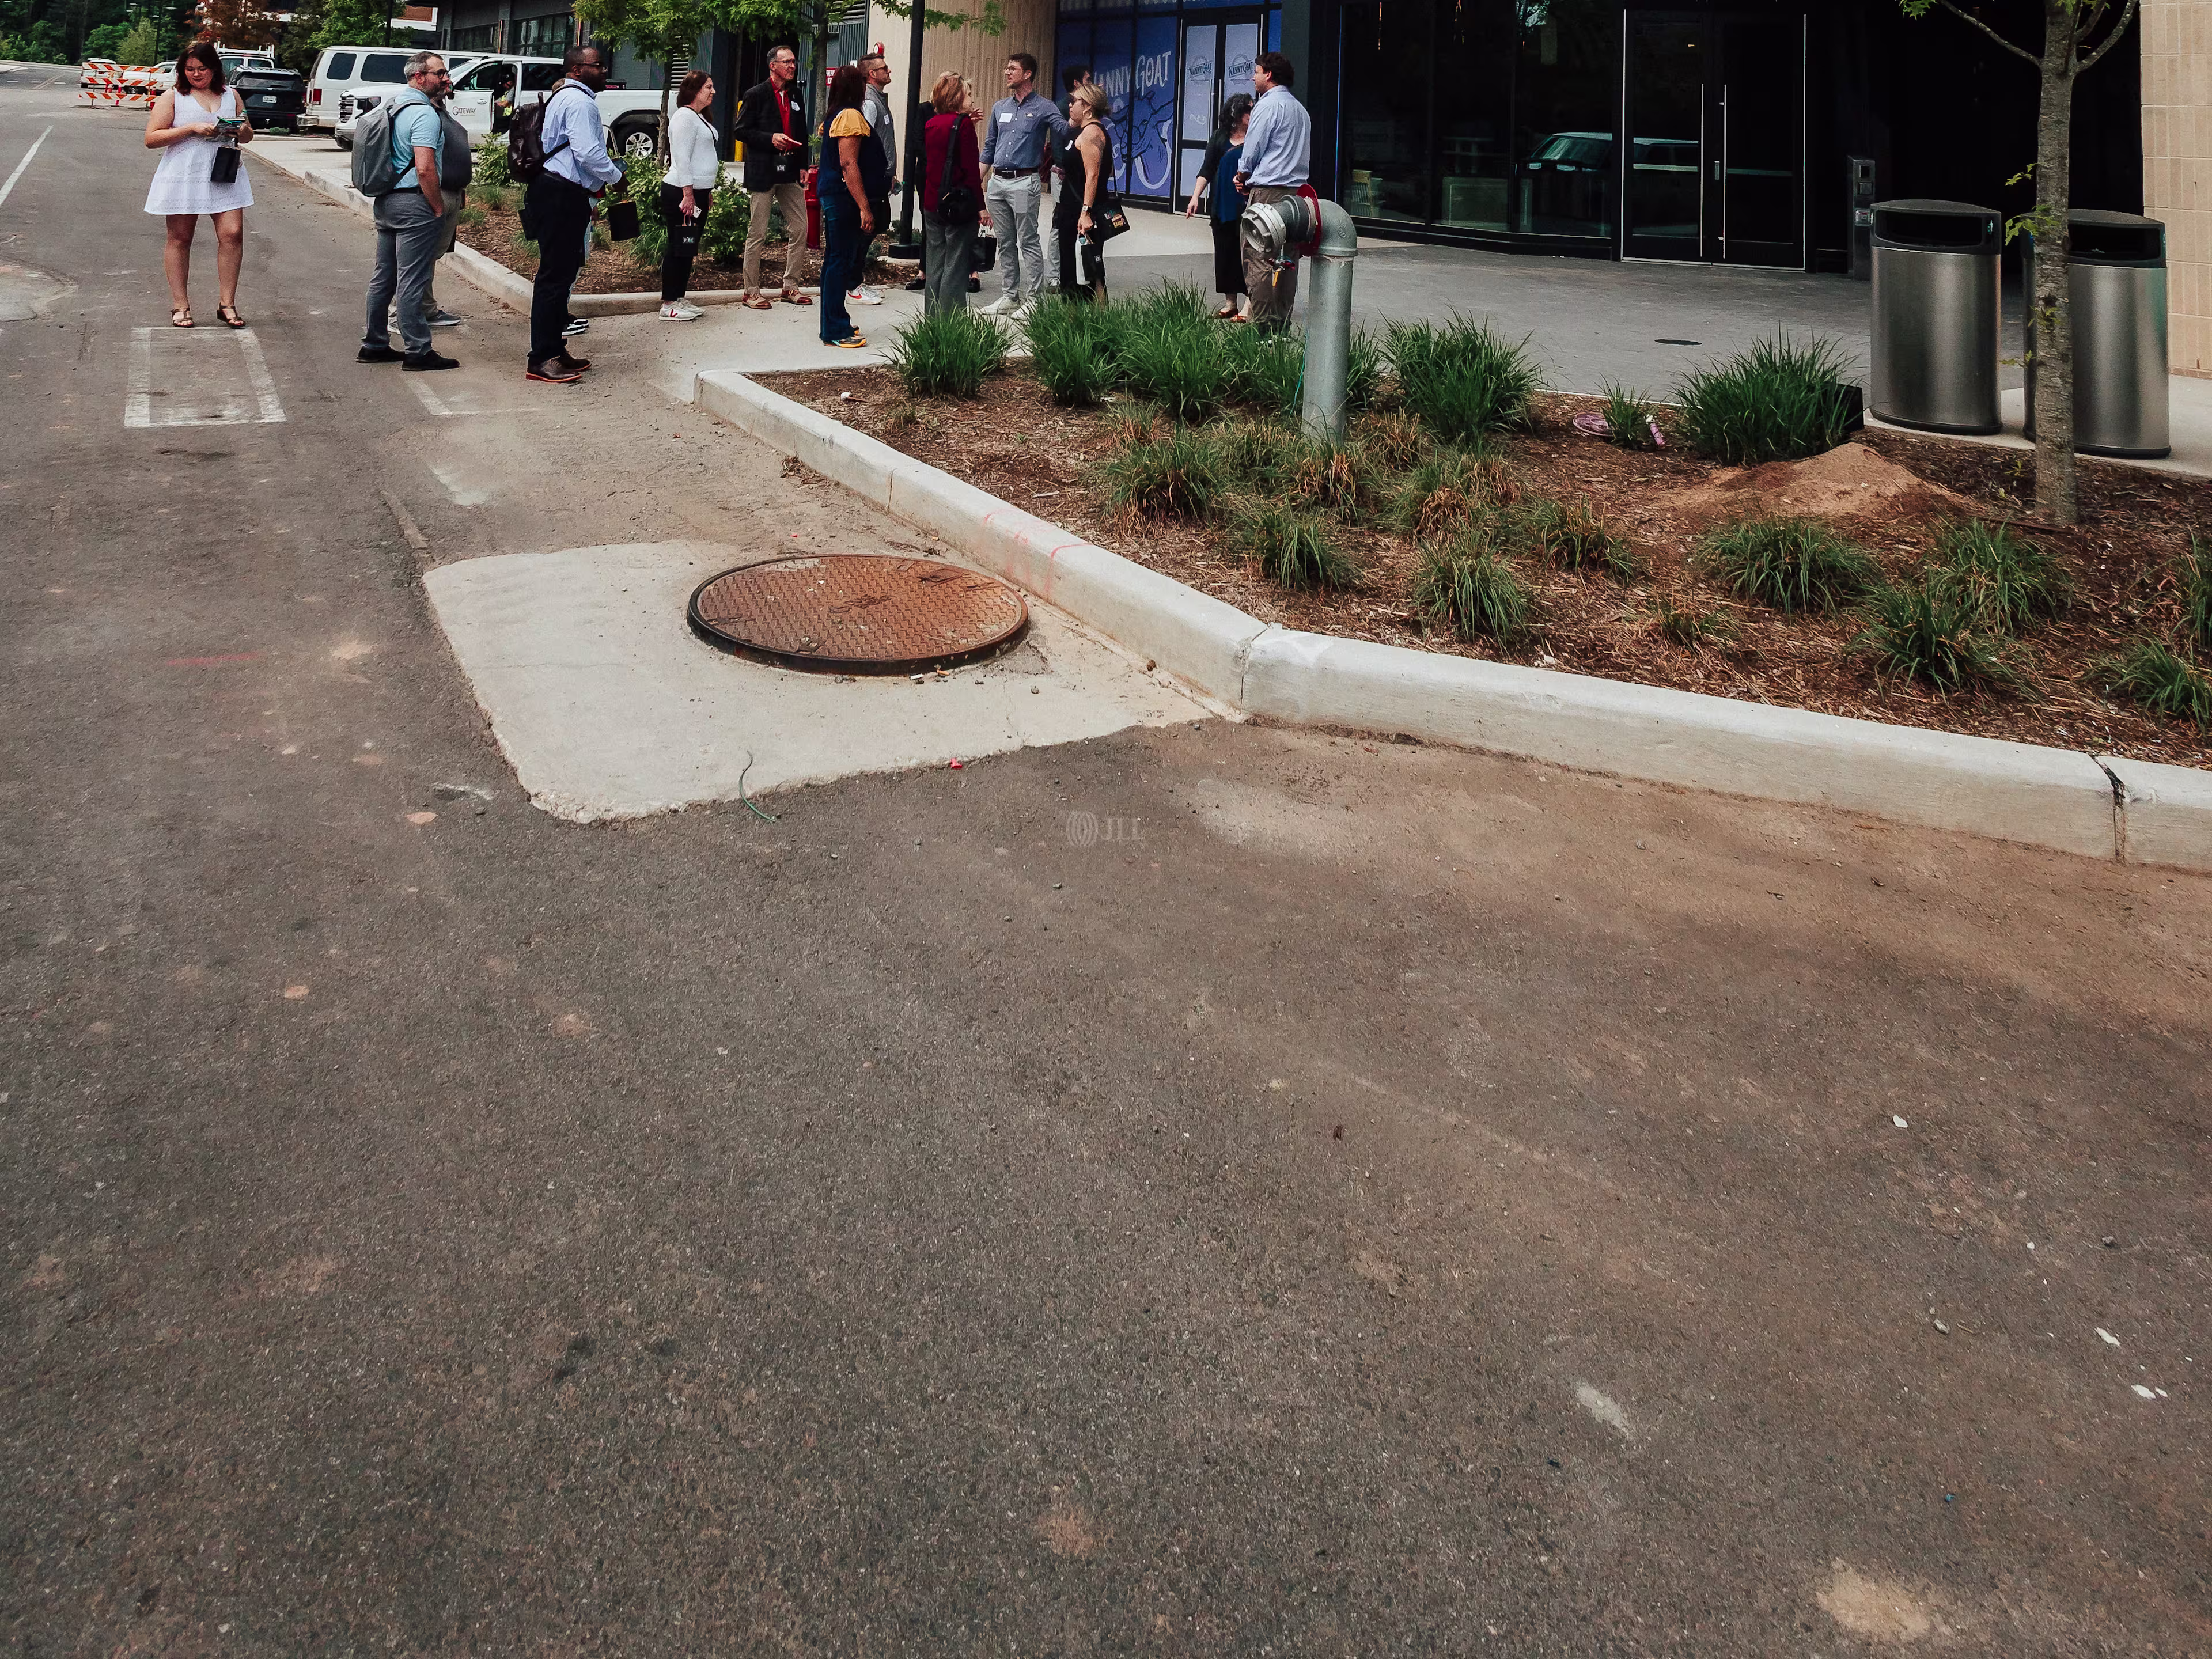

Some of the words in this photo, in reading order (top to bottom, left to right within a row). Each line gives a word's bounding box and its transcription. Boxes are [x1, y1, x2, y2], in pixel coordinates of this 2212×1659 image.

[1135, 51, 1172, 96] GOAT
[1188, 65, 1203, 78] NANNY
[1228, 65, 1243, 78] NANNY
[1243, 61, 1254, 74] GOAT
[452, 105, 476, 116] GATEWAY
